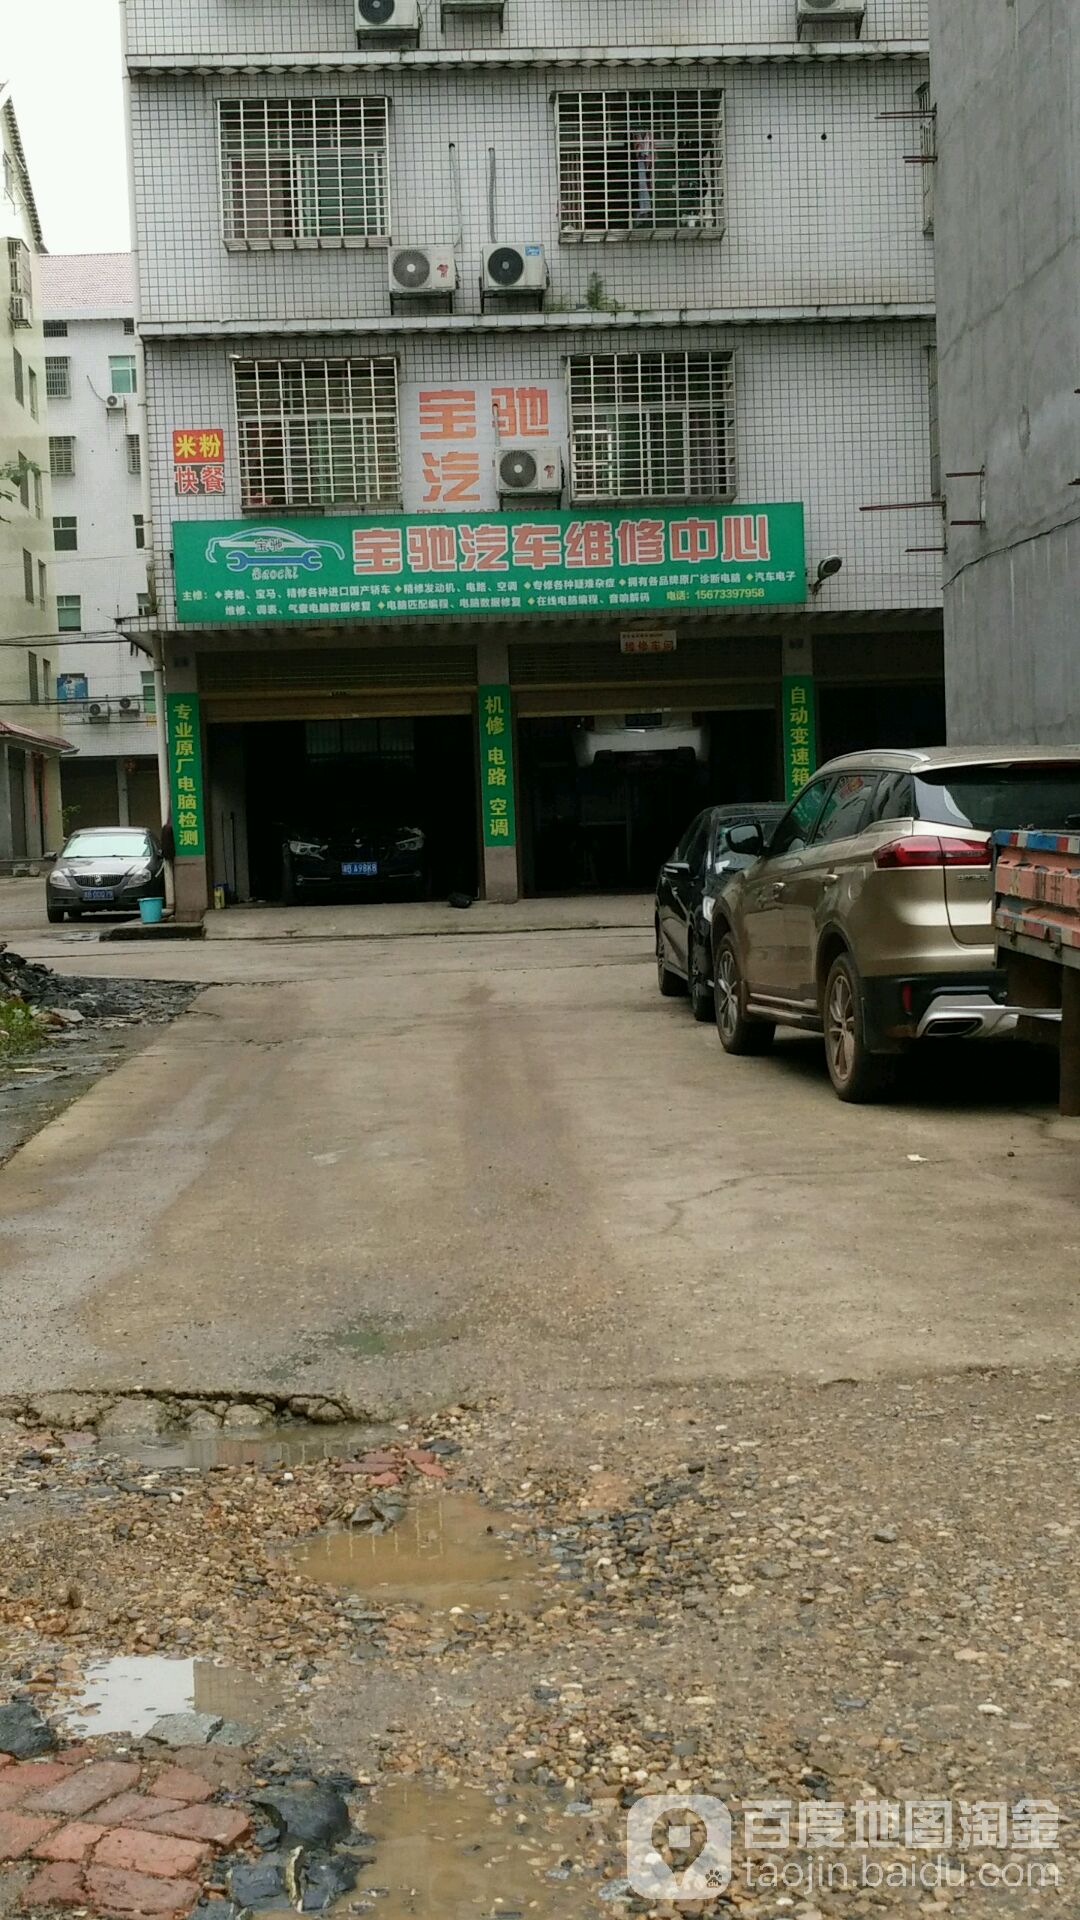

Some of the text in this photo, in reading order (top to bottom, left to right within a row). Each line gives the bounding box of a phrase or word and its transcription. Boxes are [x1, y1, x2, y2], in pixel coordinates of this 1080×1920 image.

[419, 387, 549, 440] 宝驰
[175, 433, 221, 458] 米粉
[175, 465, 224, 494] 快餐
[254, 538, 284, 552] 宝驰
[352, 514, 770, 575] 宝驰汽车维修中心
[754, 571, 796, 584] 汽车电子
[484, 695, 509, 837] 机修 电路 空调
[789, 686, 810, 798] 自动变速箱
[173, 703, 199, 846] 专业原厂电脑检测
